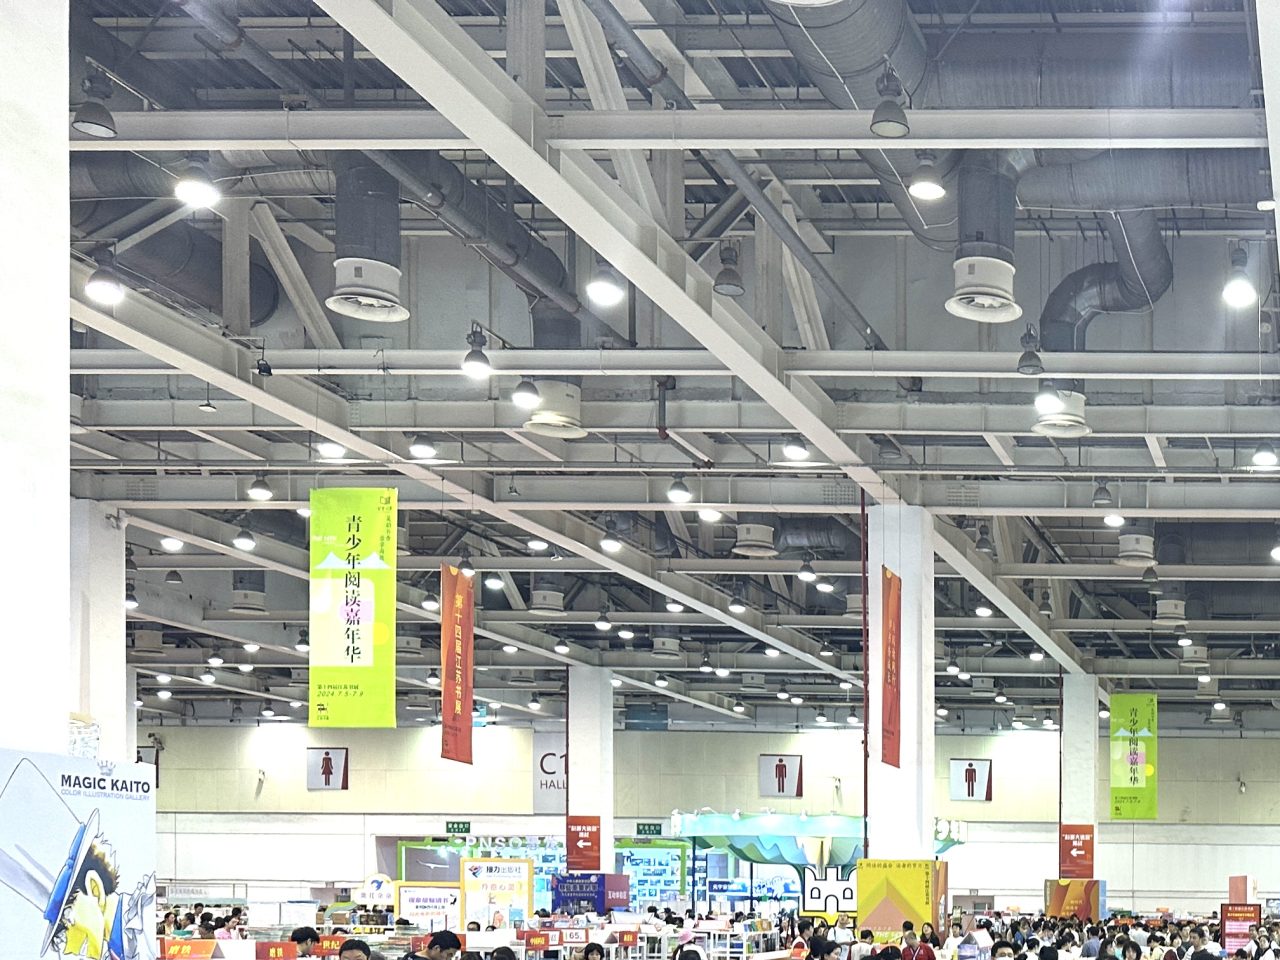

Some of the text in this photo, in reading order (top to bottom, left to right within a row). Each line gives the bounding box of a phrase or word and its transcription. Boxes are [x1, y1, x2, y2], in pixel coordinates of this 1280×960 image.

[344, 515, 362, 664] 青少年阅读嘉年华
[454, 593, 463, 714] 第十四届江苏书展
[1128, 707, 1139, 786] 青少年阅读嘉年华
[61, 774, 151, 794] MAGIC KAITO
[540, 779, 568, 790] HALL
[61, 788, 150, 801] COLOR ILLUSTRATION GALLERY
[466, 836, 523, 848] PNSO
